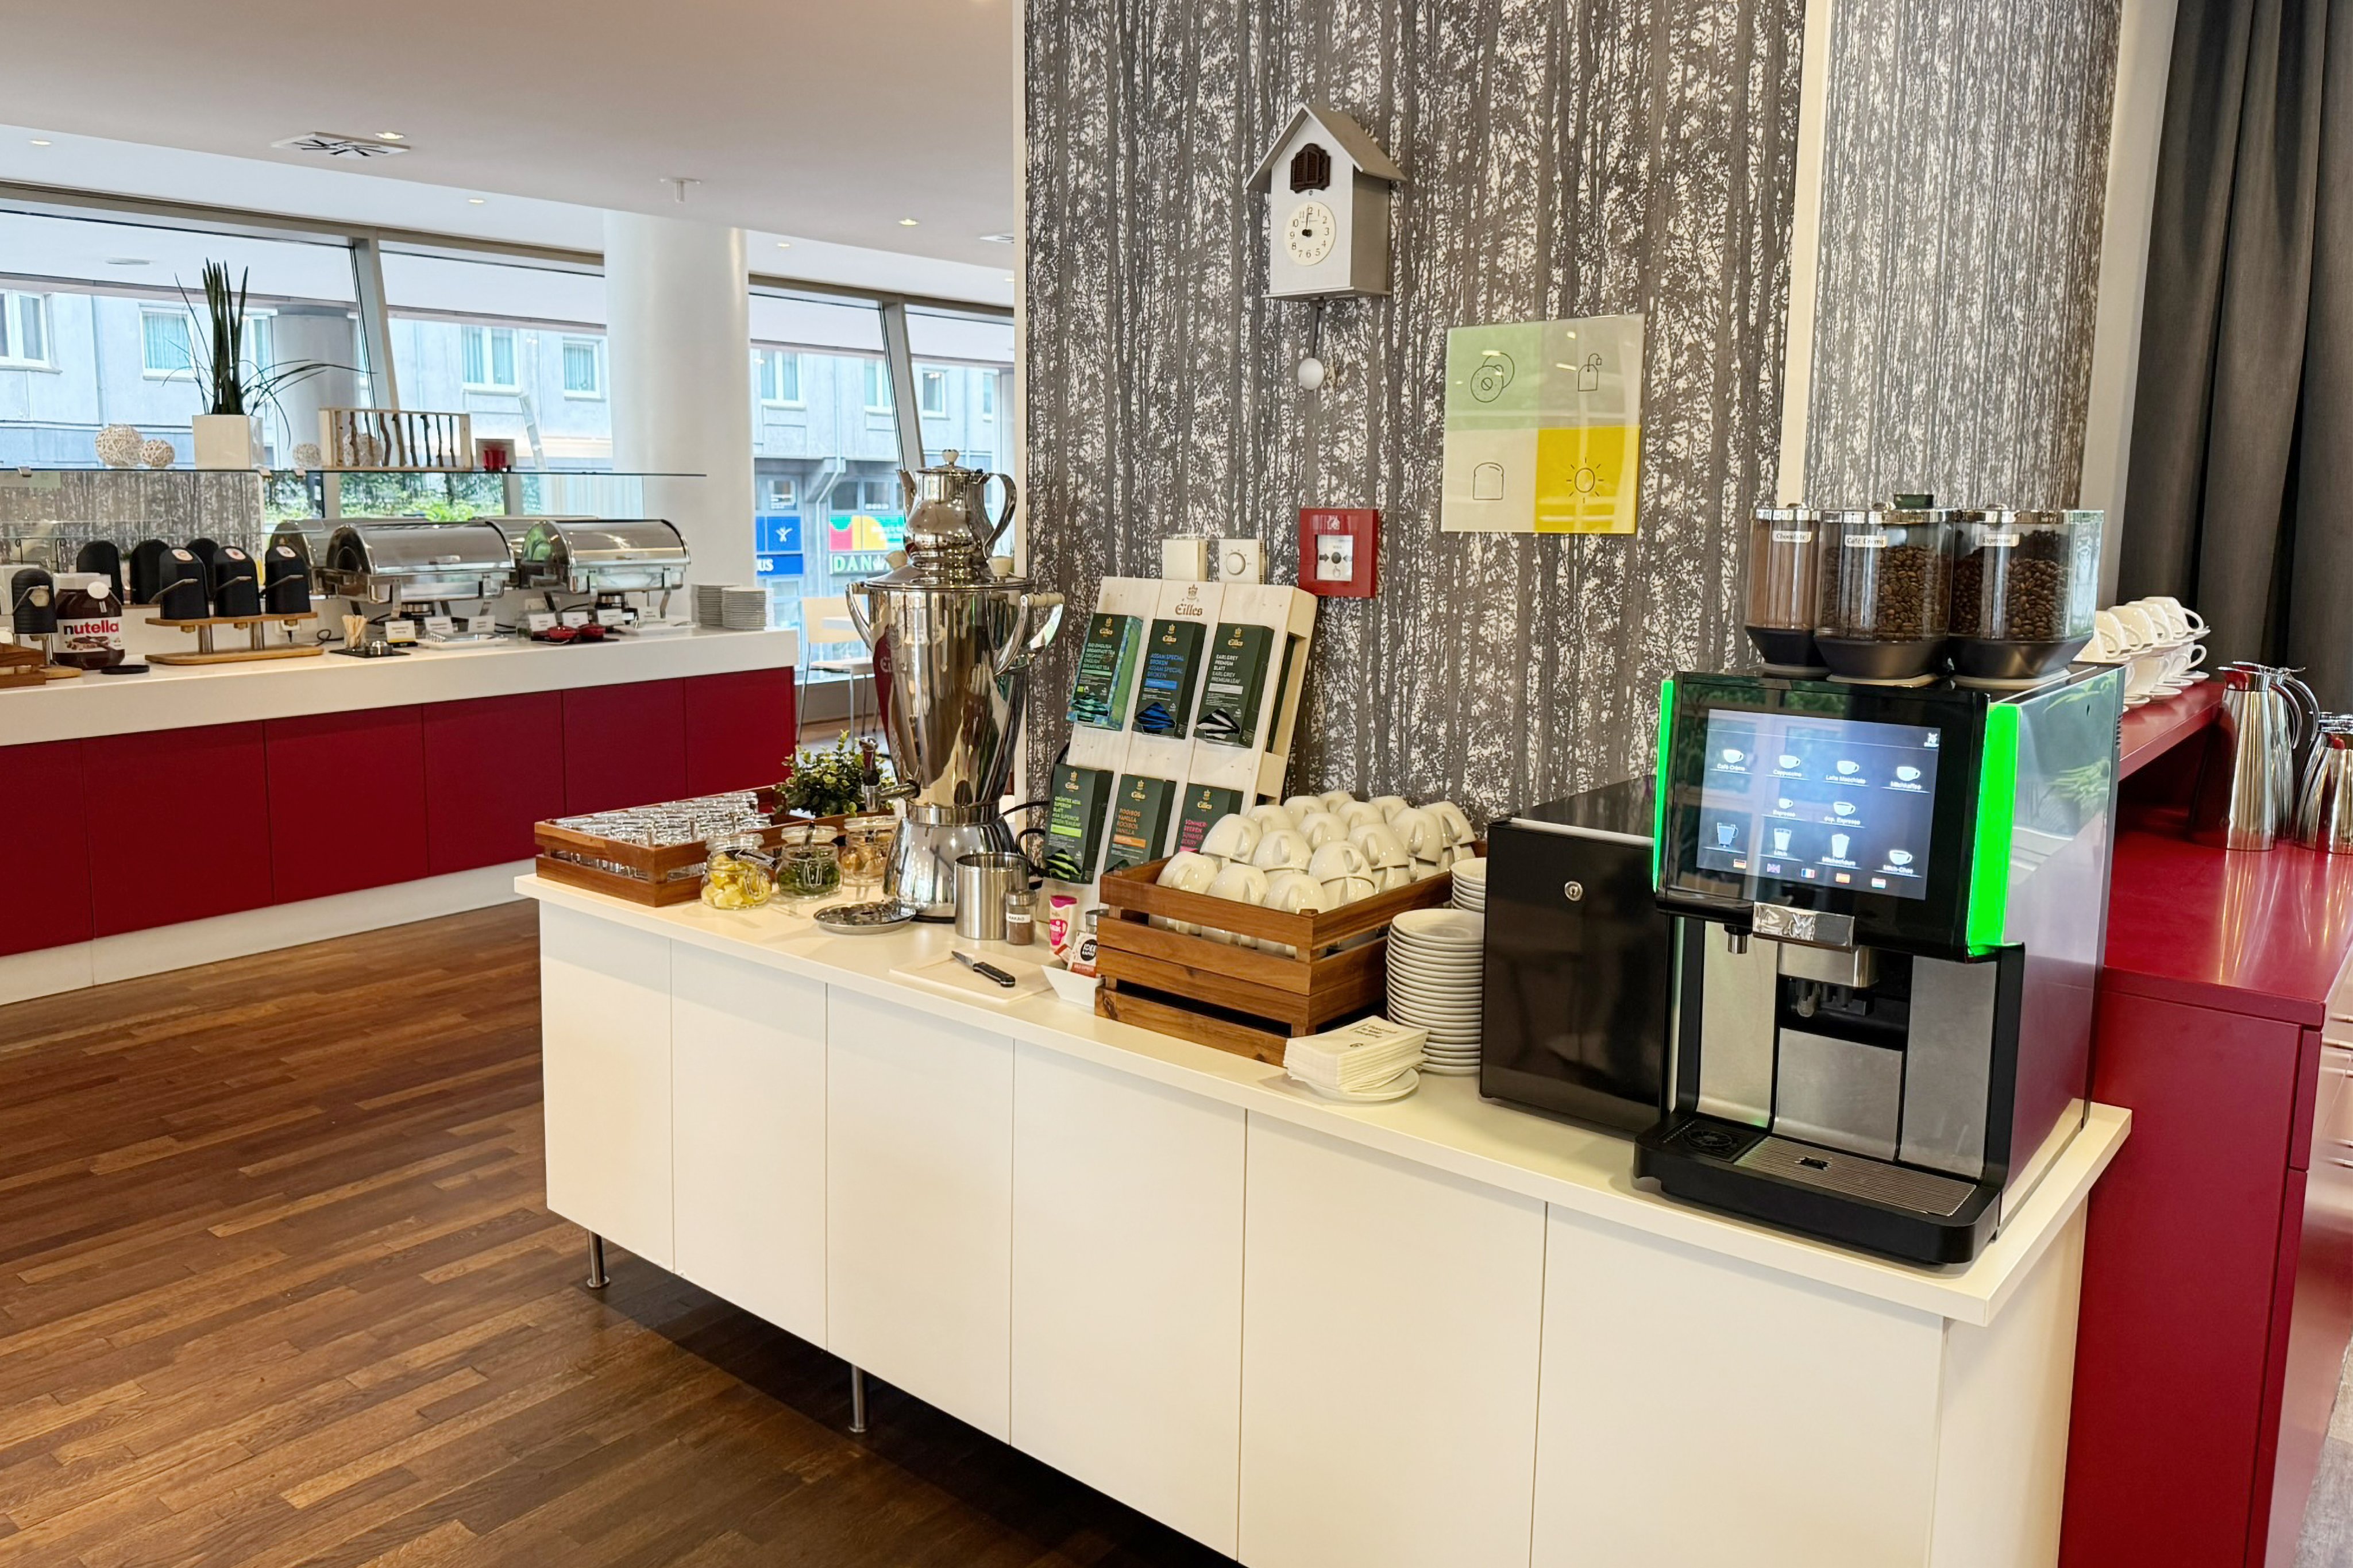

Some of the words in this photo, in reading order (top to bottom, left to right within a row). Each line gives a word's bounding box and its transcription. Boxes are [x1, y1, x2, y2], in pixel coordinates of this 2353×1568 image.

[1293, 219, 1298, 227] 10
[1323, 216, 1327, 224] 2
[1324, 227, 1329, 235] 3
[1175, 603, 1202, 616] Eilles
[63, 620, 119, 635] nutella
